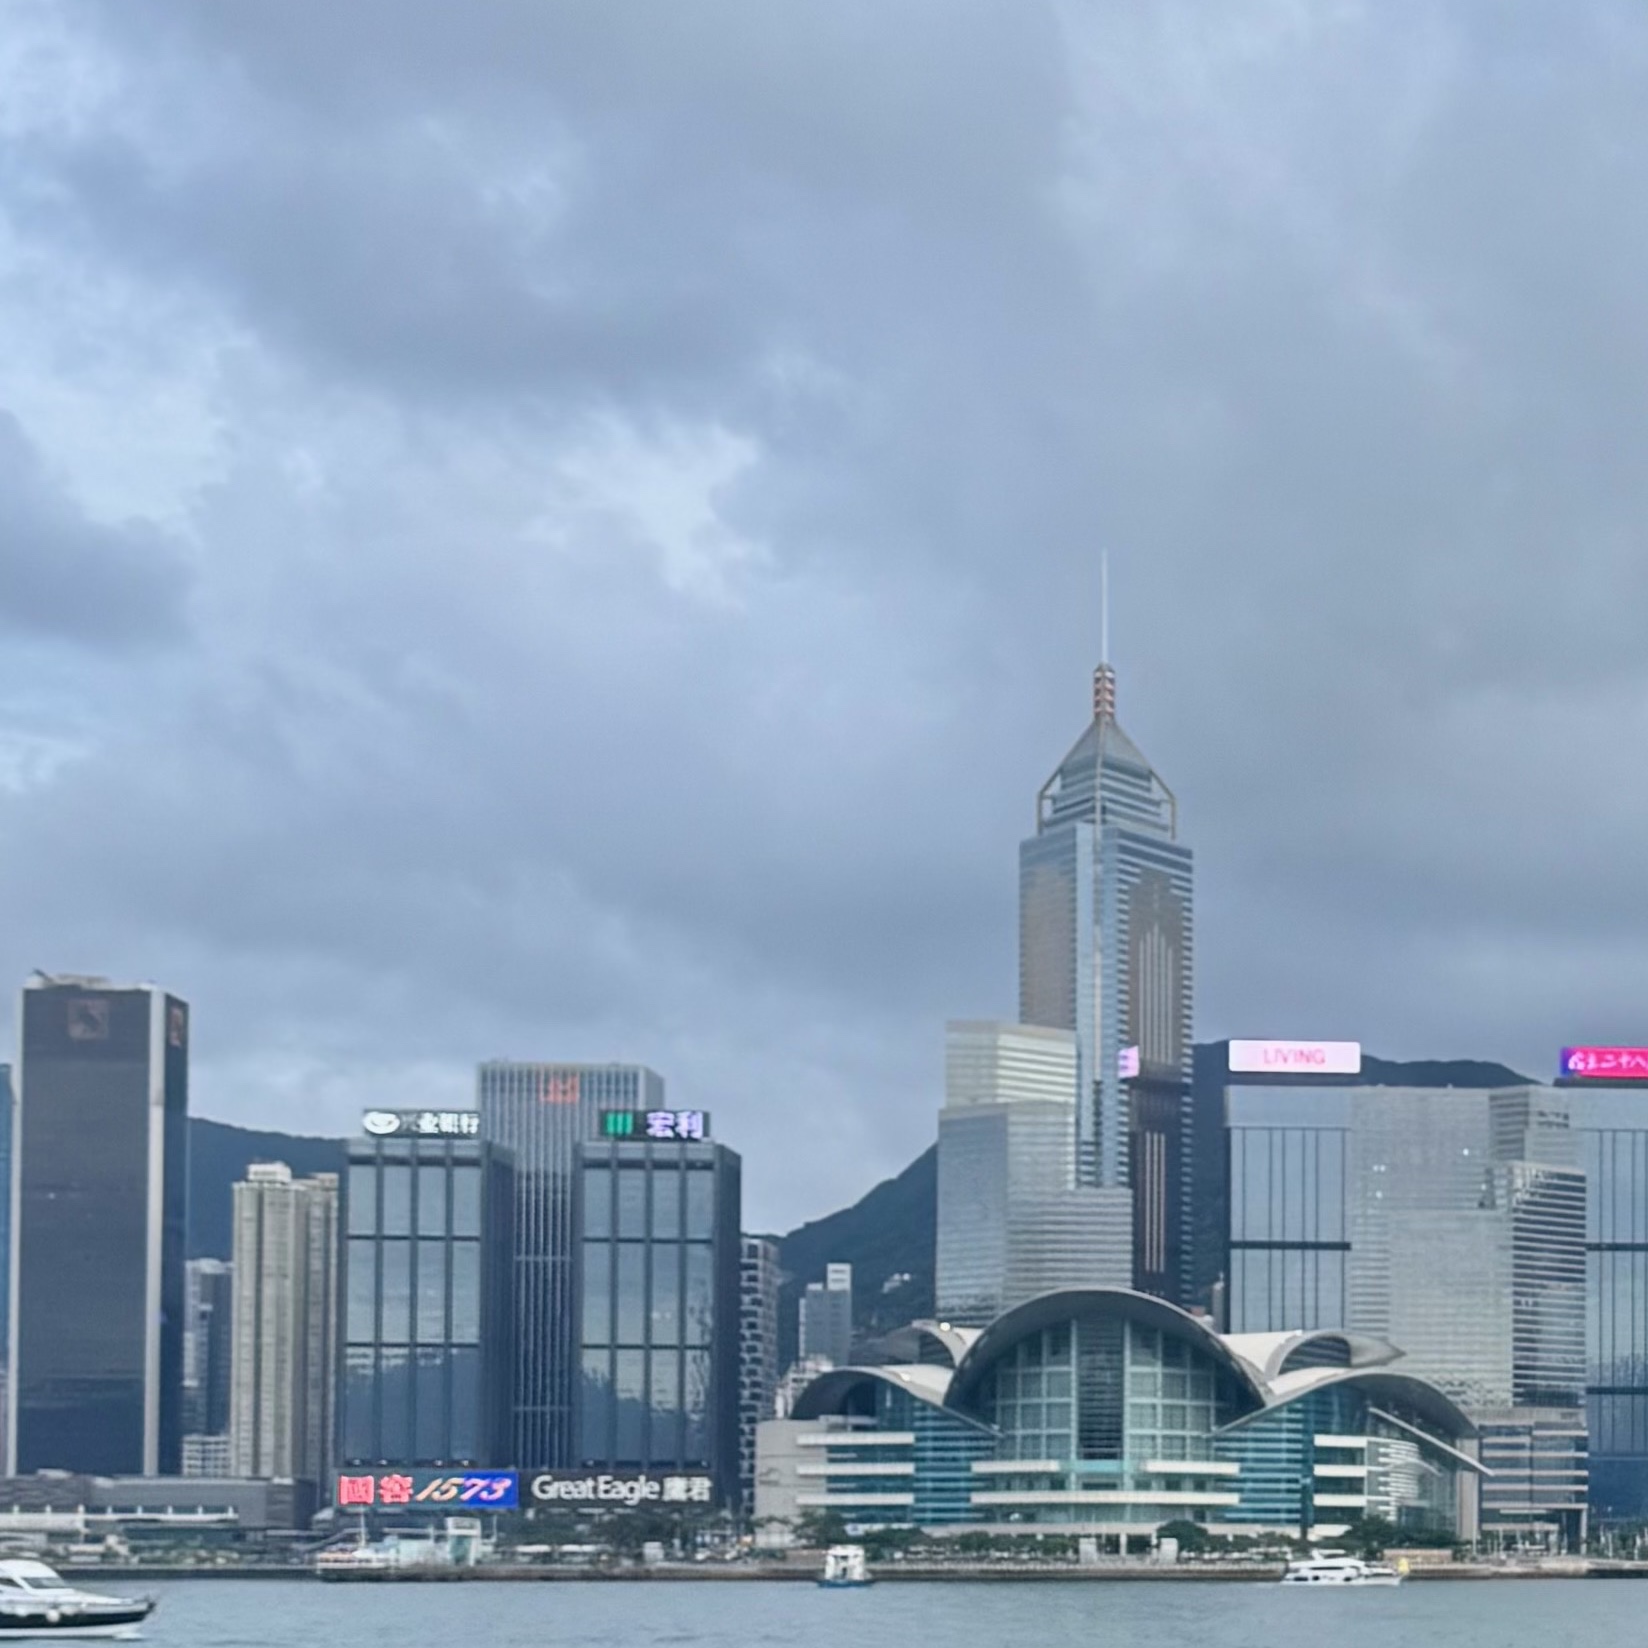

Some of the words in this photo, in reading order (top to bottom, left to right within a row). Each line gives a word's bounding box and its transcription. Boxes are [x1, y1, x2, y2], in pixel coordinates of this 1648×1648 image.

[1263, 1048, 1326, 1064] LIVING
[415, 1477, 512, 1501] 1573
[531, 1474, 595, 1500] Great
[597, 1475, 661, 1506] Eagle
